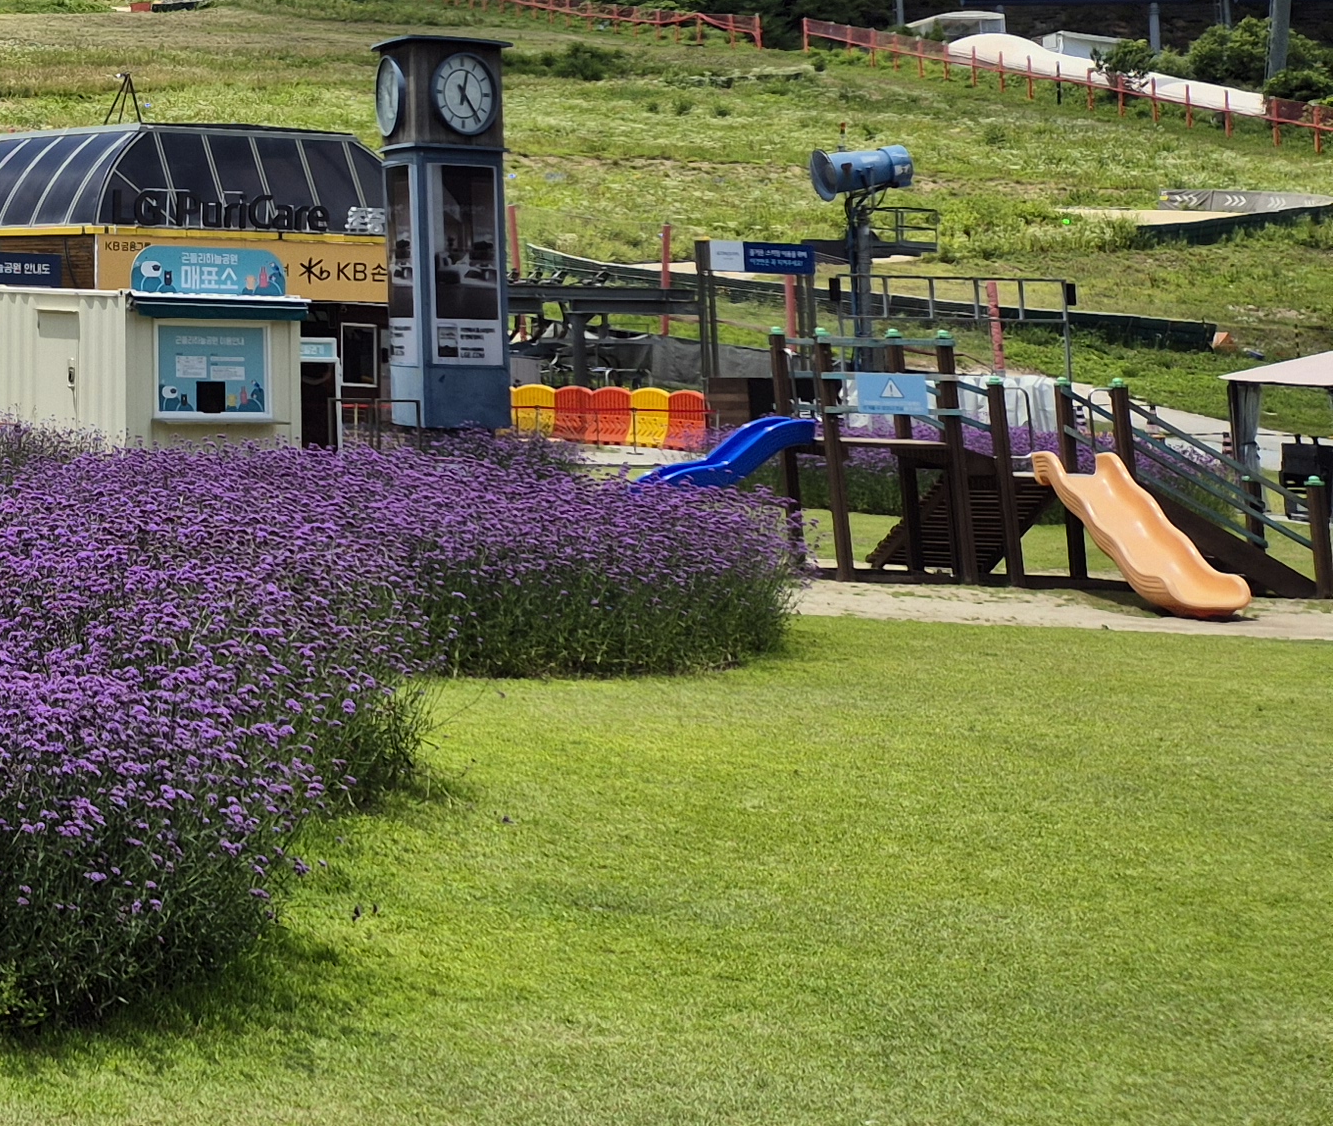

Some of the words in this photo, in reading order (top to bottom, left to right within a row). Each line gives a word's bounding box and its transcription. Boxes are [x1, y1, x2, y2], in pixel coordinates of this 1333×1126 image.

[111, 188, 163, 226] LG
[175, 190, 331, 232] PuriCare
[23, 262, 51, 275] 안내도
[180, 265, 239, 290] 매표소
